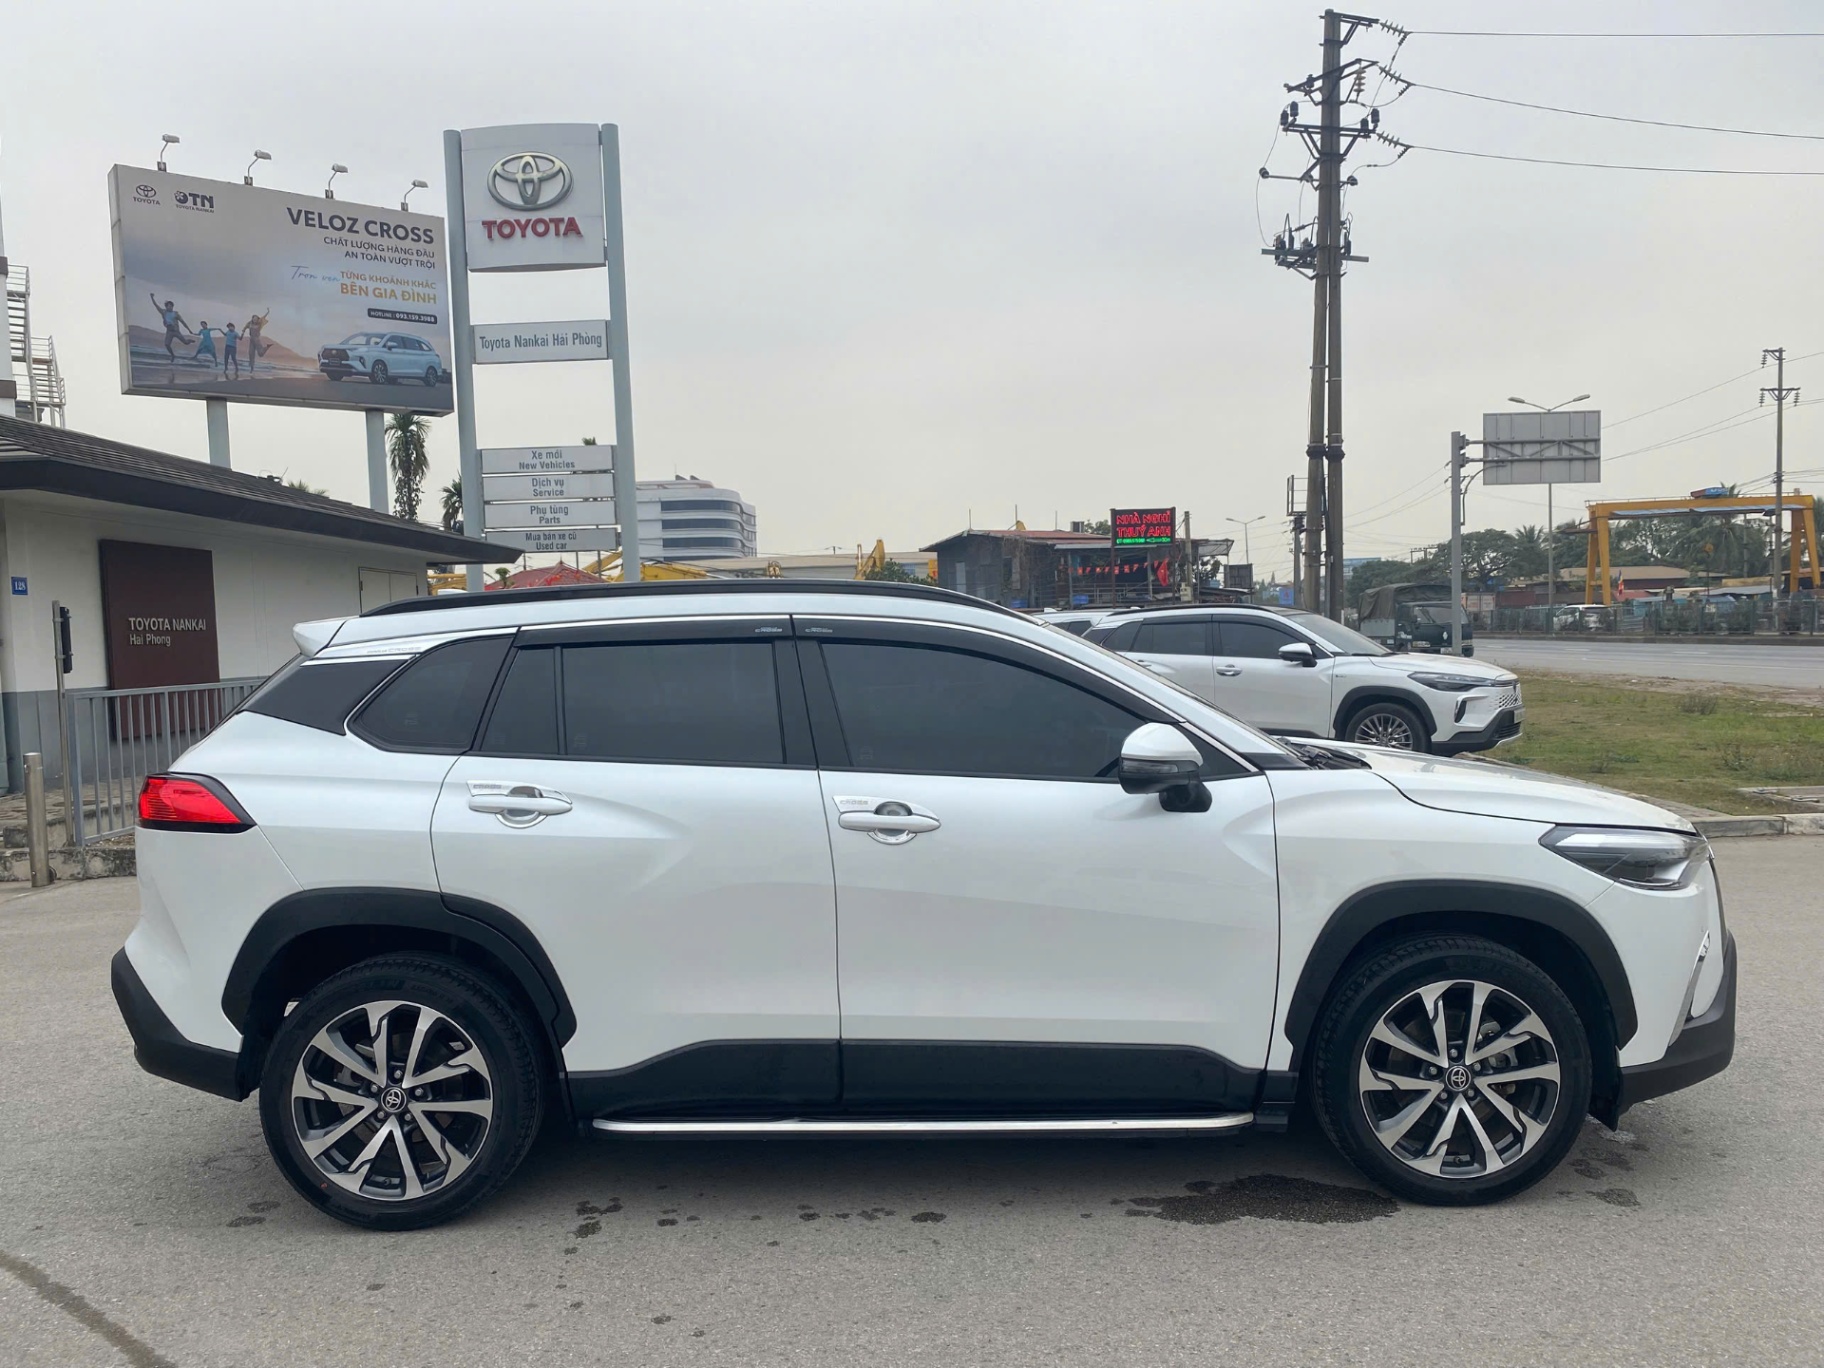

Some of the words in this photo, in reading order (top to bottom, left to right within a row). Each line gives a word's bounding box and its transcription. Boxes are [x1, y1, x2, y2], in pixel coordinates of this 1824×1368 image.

[133, 197, 161, 205] TOYOTA
[286, 207, 360, 234] VELOZ
[364, 219, 434, 244] CROSS
[482, 216, 583, 241] TOYOTA
[350, 240, 385, 252] LƯỢNG
[386, 244, 414, 256] HÀNG
[344, 250, 359, 260] AN
[360, 251, 387, 263] TOÀN
[387, 256, 414, 267] VƯỢT
[415, 259, 436, 270] TRỘI
[340, 281, 369, 297] BÊN
[372, 287, 399, 300] GIA
[401, 287, 437, 305] ĐÌNH
[479, 336, 511, 352] Toyota
[514, 334, 549, 348] Nankai
[572, 331, 602, 348] Phòng
[531, 450, 543, 460] Xe
[518, 461, 537, 470] New
[539, 460, 575, 469] Vehicles
[531, 477, 552, 489] Dịch
[553, 479, 564, 489] vụ
[532, 488, 565, 497] Service
[530, 505, 547, 516] Phụ
[549, 504, 569, 516] tùng
[539, 516, 561, 525] Parts
[1116, 511, 1141, 525] NHÀ
[1142, 510, 1171, 524] NGHỈ
[525, 532, 541, 541] Mua
[558, 533, 566, 541] xe
[1146, 526, 1171, 537] ANH
[535, 541, 554, 550] Used
[555, 542, 567, 550] car
[14, 580, 27, 591] 128
[128, 617, 171, 631] TOYOTA
[172, 618, 207, 631] NANKAI
[129, 633, 144, 645] Hai
[145, 633, 171, 647] Phong
